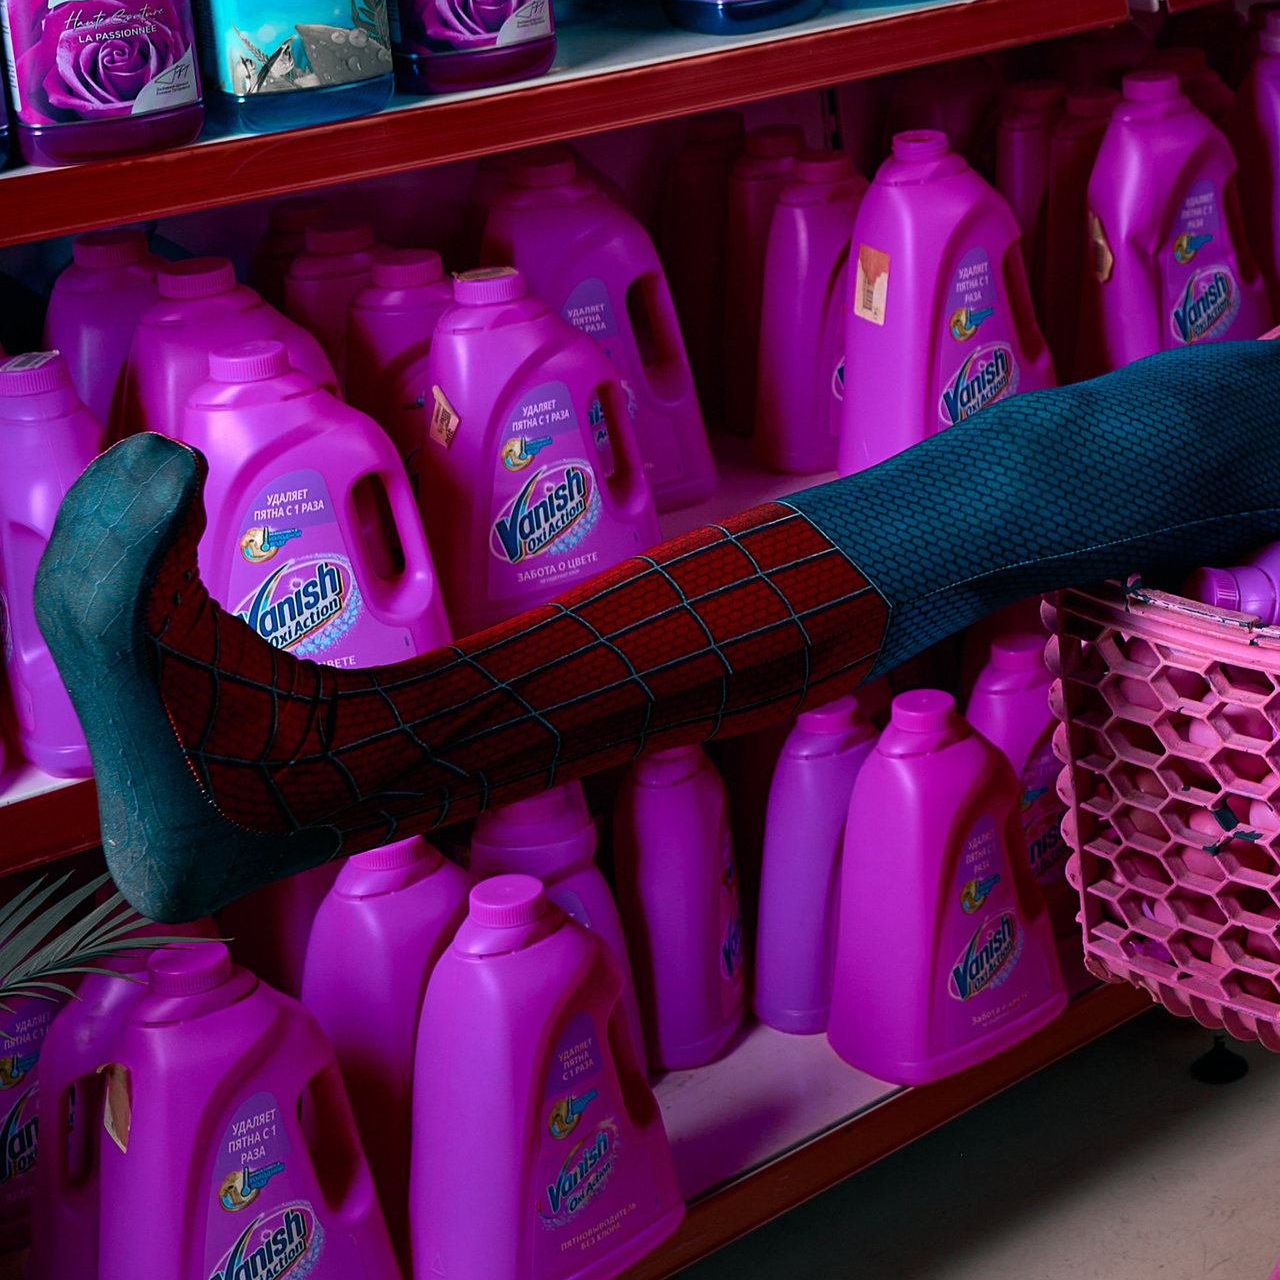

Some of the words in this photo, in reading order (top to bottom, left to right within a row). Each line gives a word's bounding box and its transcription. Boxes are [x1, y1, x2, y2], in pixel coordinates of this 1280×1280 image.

[78, 34, 93, 43] LA
[958, 262, 988, 279] УДАЛЯЕТ
[956, 280, 979, 292] ПЯТНА
[964, 291, 982, 303] РАЗА
[567, 304, 604, 318] УДАЛЯЕТ
[1174, 268, 1229, 343] Vanish
[573, 315, 601, 326] ПЯТНА
[943, 346, 1008, 424] Vanish
[523, 399, 556, 417] УДАЛЯЕТ
[512, 419, 537, 432] ПЯТНА
[551, 409, 570, 422] РАЗА
[267, 489, 308, 506] УДАЛЯЕТ
[254, 507, 284, 521] ПЯТНА
[301, 499, 325, 513] РАЗА
[495, 465, 585, 563] Vanish
[527, 532, 548, 554] Oxi
[549, 498, 585, 537] Action
[517, 563, 556, 582] ЗАБОТА
[567, 552, 598, 567] ЦВЕТЕ
[235, 558, 344, 638] Vanish
[294, 597, 342, 636] Action
[953, 916, 1014, 1001] Vanish
[558, 1038, 592, 1061] УДАЛЯЕТ
[563, 1052, 589, 1070] ПЯТНА
[575, 1058, 594, 1076] РАЗА
[231, 1109, 276, 1136] УДАЛЯЕТ
[228, 1133, 261, 1153] ПЯТНА
[240, 1149, 266, 1164] РАЗА
[547, 1130, 609, 1214] Vanish
[569, 1192, 585, 1212] Oxi
[586, 1162, 611, 1196] Action
[580, 1236, 596, 1251] БЕЗ
[596, 1222, 621, 1241] ХЛОРА
